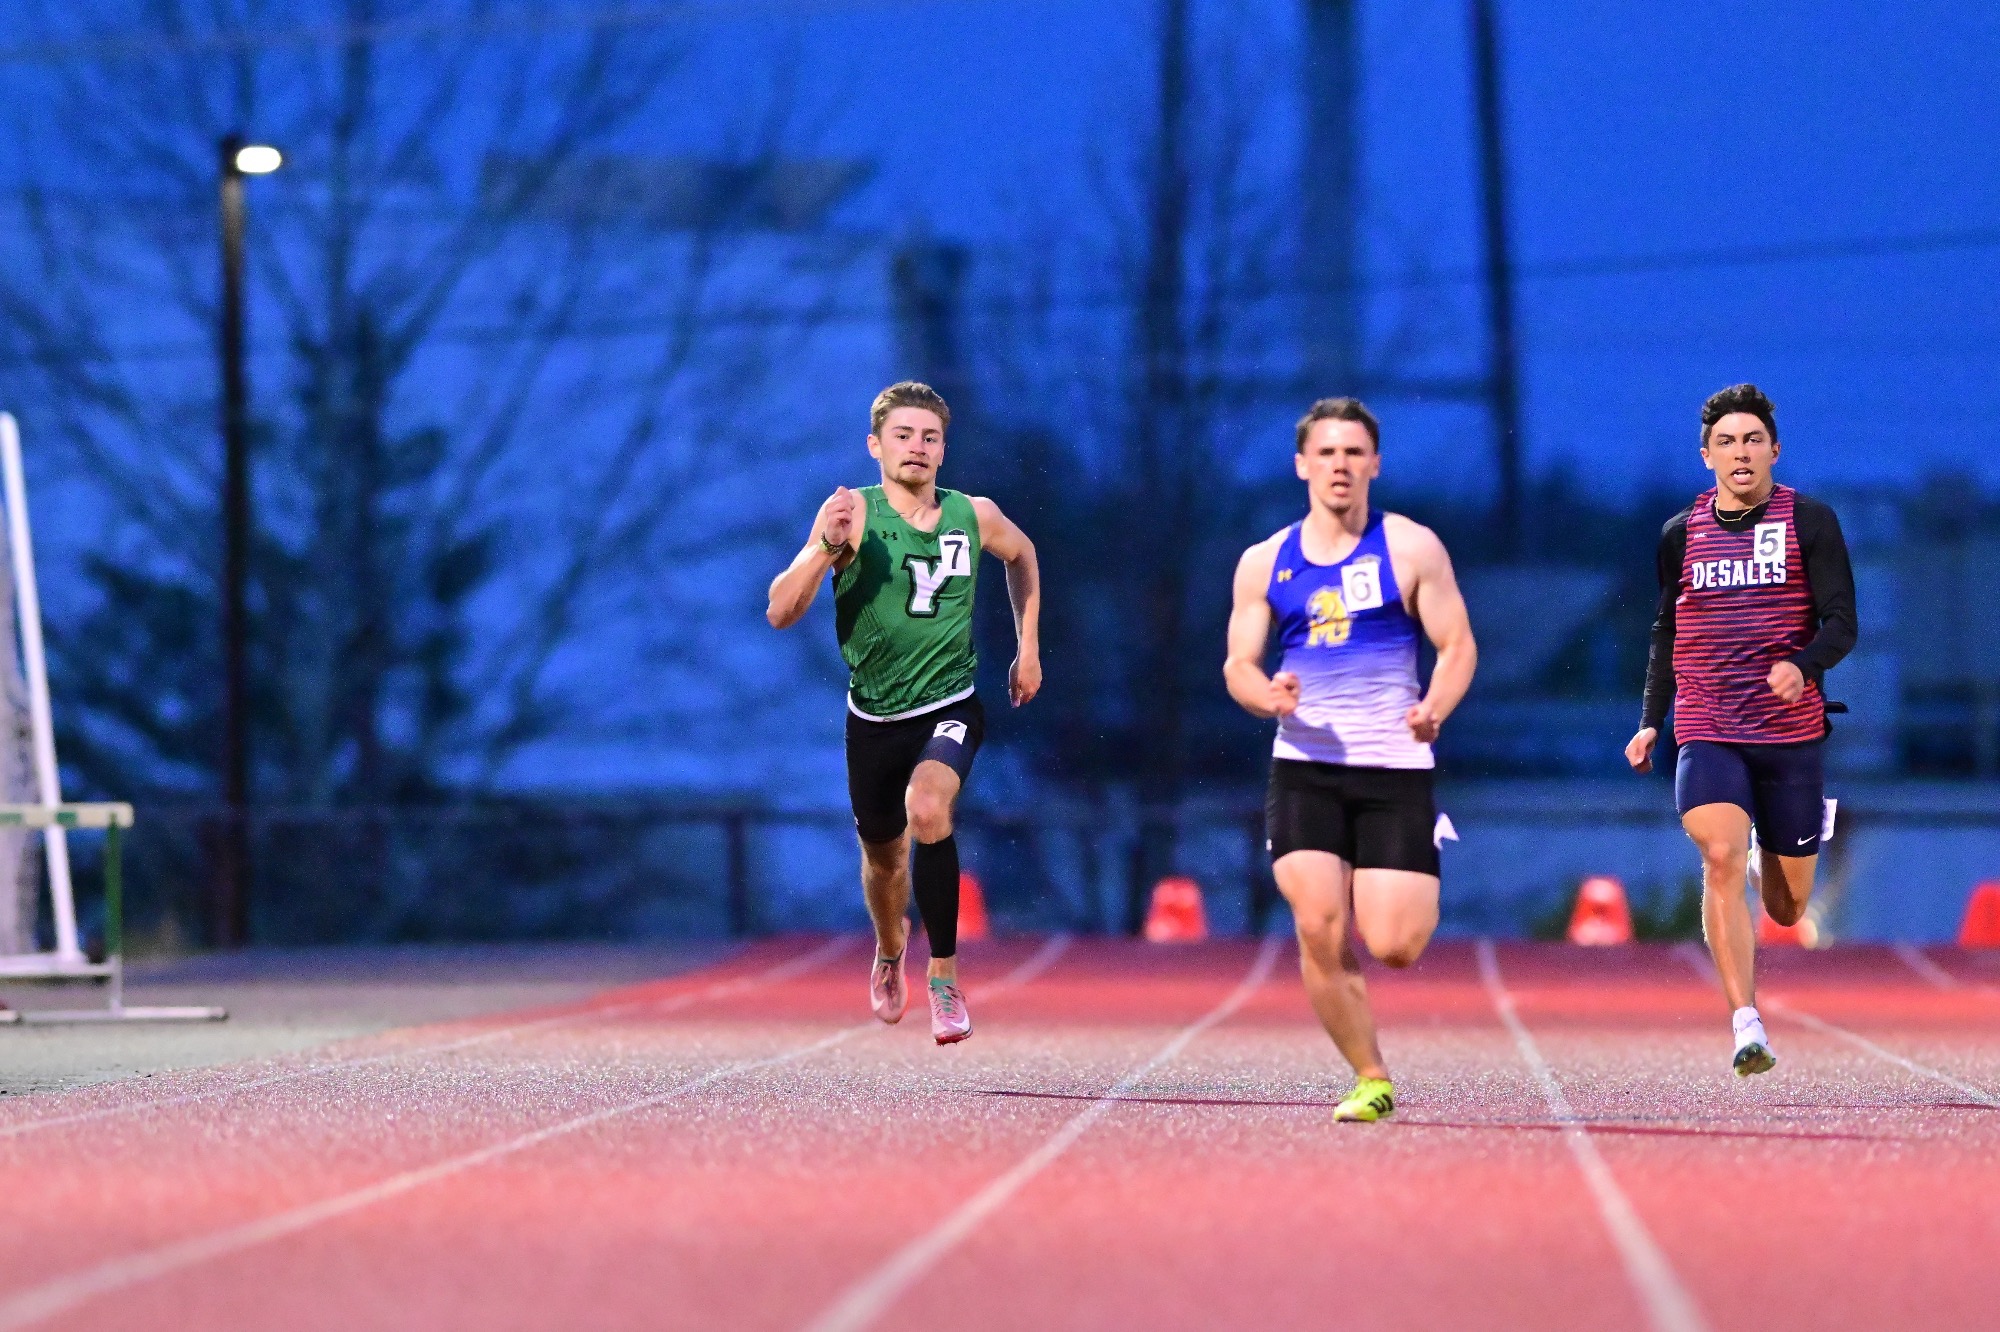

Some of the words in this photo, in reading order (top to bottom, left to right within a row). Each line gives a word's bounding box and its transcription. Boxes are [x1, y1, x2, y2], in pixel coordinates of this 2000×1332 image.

[944, 540, 963, 570] 7
[1758, 528, 1779, 557] 5
[901, 552, 954, 618] Y
[1350, 571, 1372, 602] 6
[1692, 559, 1787, 590] DESALES
[941, 722, 961, 733] 7
